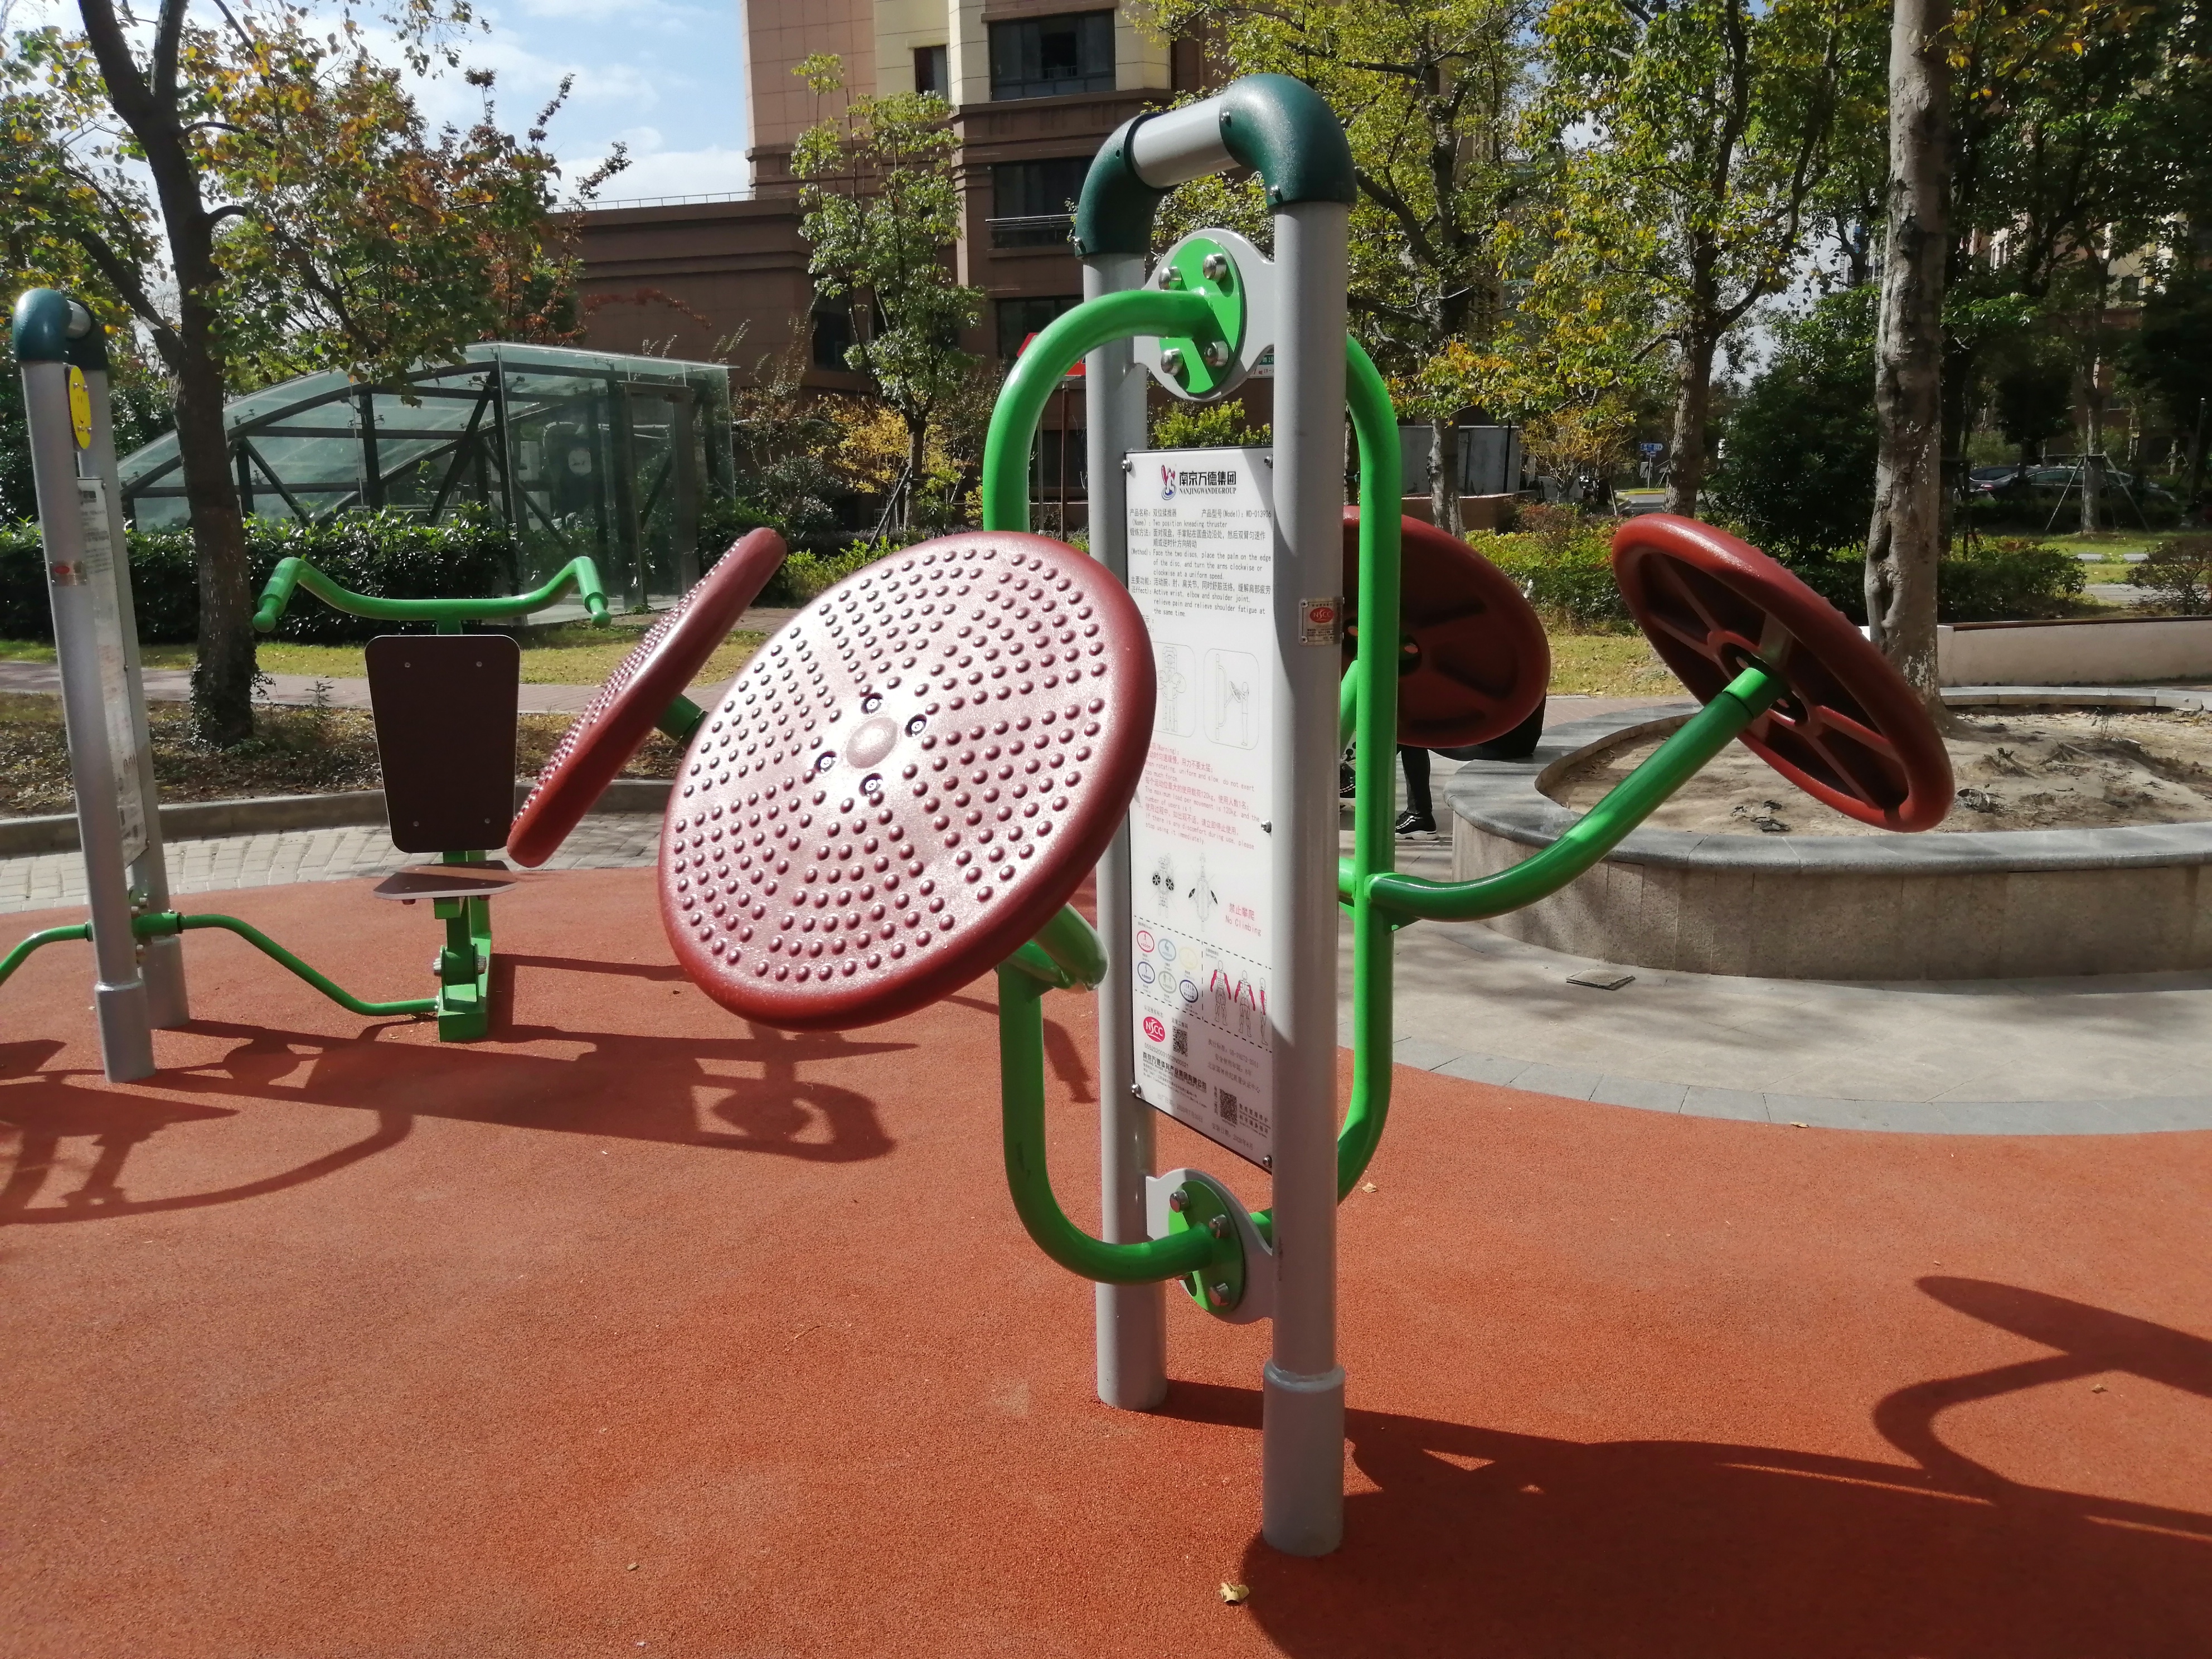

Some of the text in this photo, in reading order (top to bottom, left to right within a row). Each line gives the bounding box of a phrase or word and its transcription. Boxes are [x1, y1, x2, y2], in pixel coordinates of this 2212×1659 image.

[1179, 471, 1236, 486] 南京万德集团
[1260, 554, 1271, 562] edge
[1215, 603, 1235, 612] shoulder
[1238, 605, 1257, 614] fatigue
[1313, 609, 1331, 619] NSCC
[1180, 769, 1197, 777] uniform
[1194, 801, 1214, 809] movement
[1157, 826, 1169, 835] using
[1182, 823, 1206, 836] discomfort
[1209, 831, 1224, 842] during
[1238, 840, 1254, 850] please
[1229, 903, 1255, 921] 禁止攀爬
[1225, 915, 1262, 937] No Climbing
[1146, 1019, 1163, 1037] NSCC
